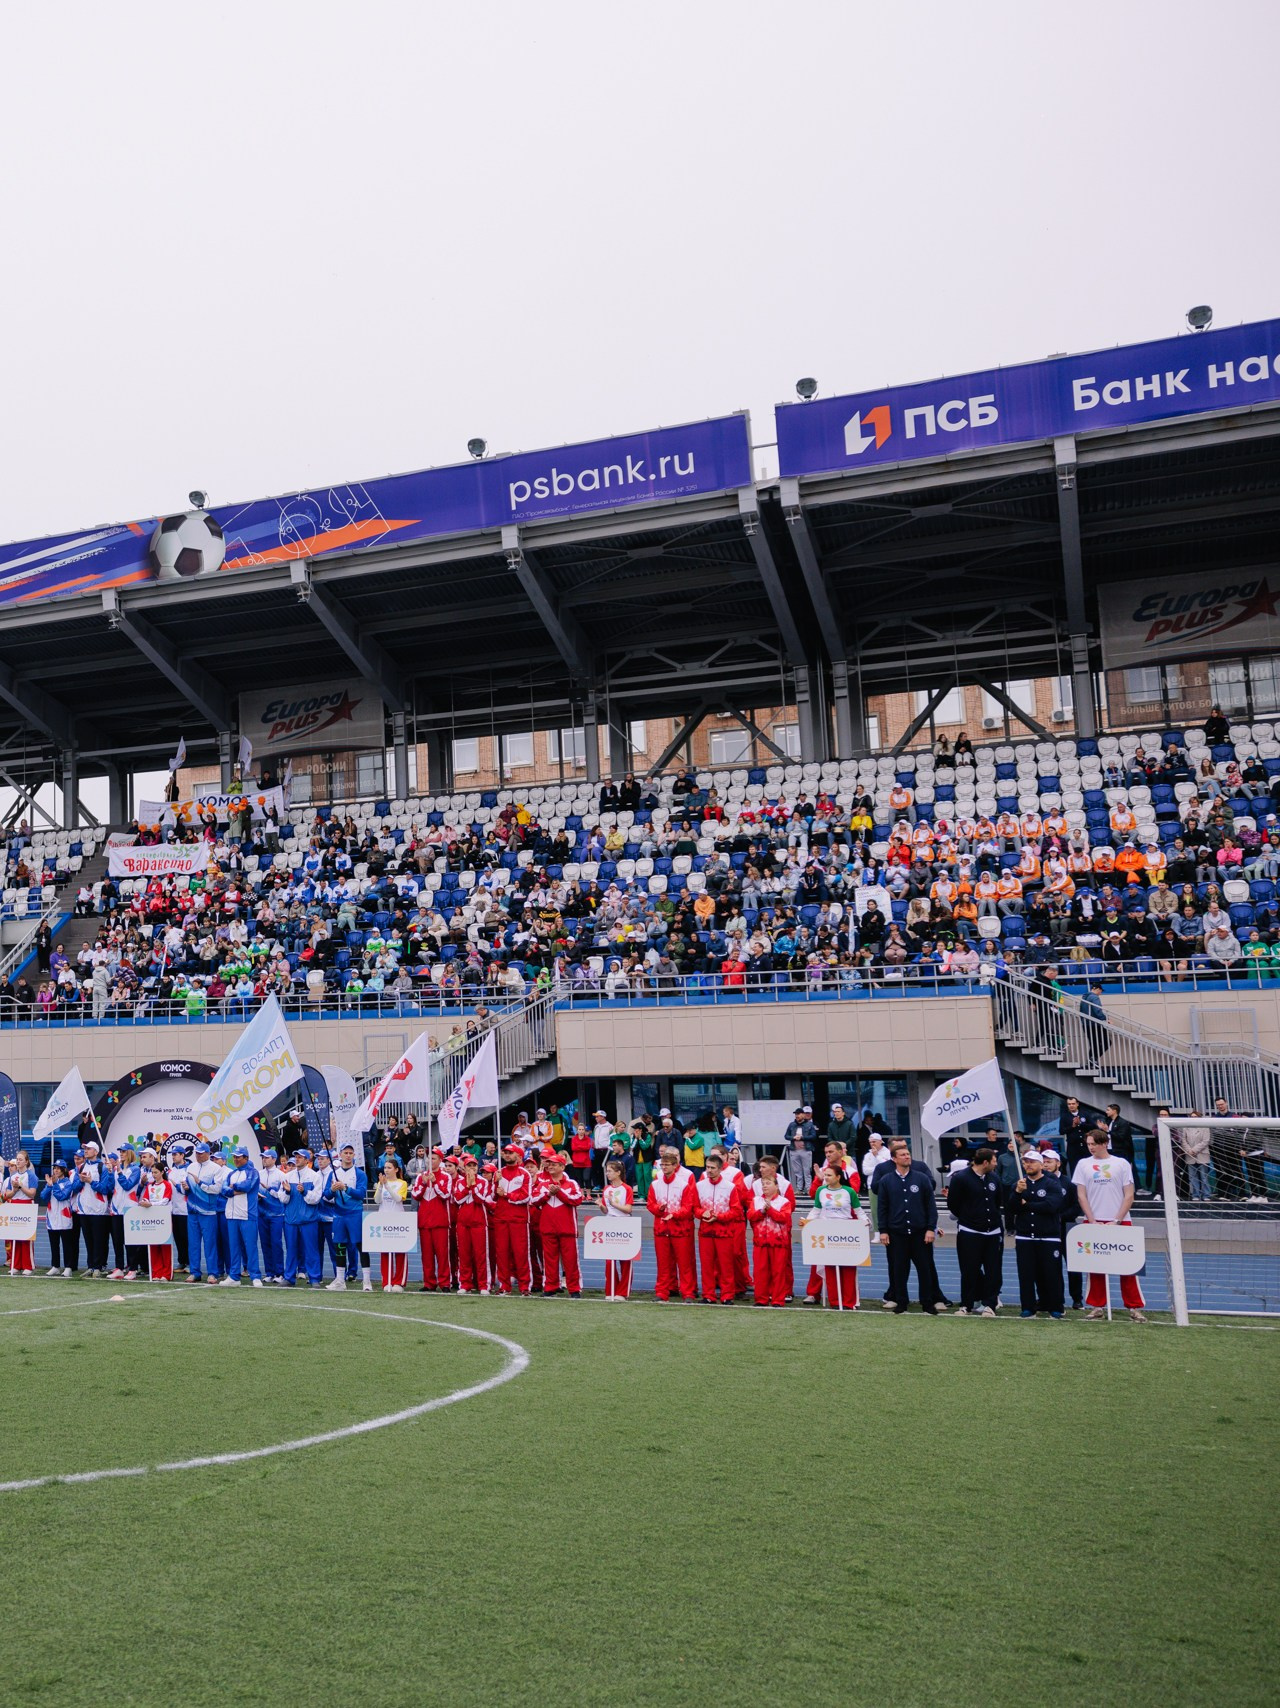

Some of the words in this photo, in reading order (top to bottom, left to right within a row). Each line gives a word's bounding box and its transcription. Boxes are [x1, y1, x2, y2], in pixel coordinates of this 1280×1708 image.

[1071, 368, 1192, 412] Банк
[904, 394, 999, 440] ПСБ
[509, 452, 695, 511] psbank.ru
[1133, 580, 1260, 622] Europa
[1209, 666, 1270, 683] РОССИИ
[261, 692, 343, 724] Europa
[1120, 703, 1161, 715] БОЛЬШЕ
[1162, 699, 1197, 711] ХИТОВ!
[306, 761, 347, 774] РОССИИ
[123, 857, 192, 874] Вараксино
[160, 1064, 191, 1072] КОМОС
[163, 1134, 184, 1150] КОМОС
[827, 1235, 860, 1243] КОМОС
[1093, 1242, 1134, 1252] КОМОС
